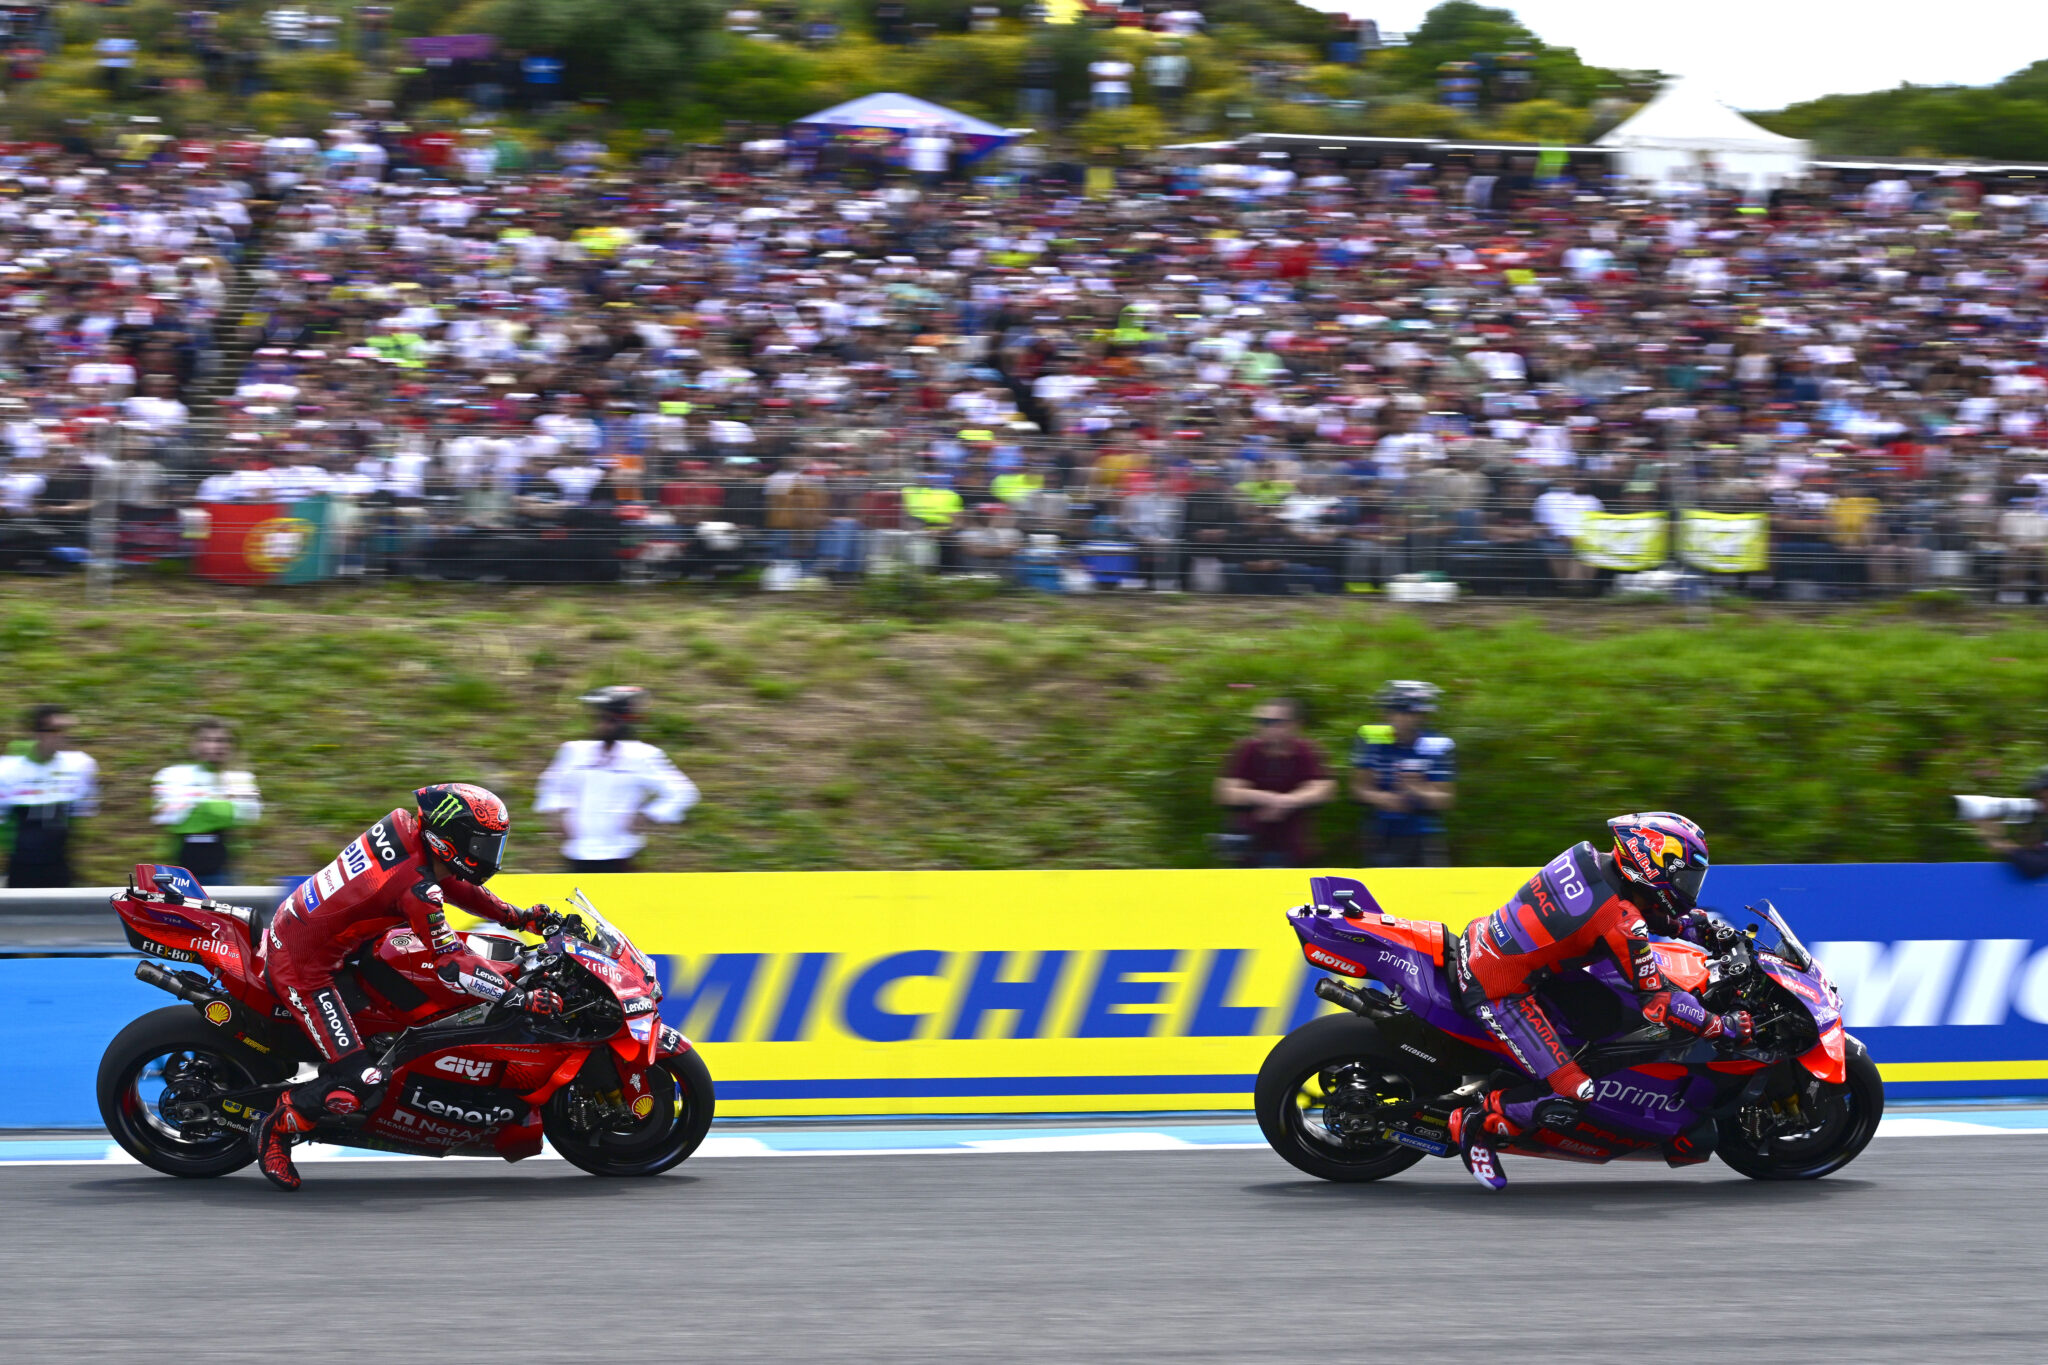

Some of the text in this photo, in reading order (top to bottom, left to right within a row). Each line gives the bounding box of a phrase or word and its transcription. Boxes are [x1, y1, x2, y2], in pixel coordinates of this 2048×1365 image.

[453, 856, 475, 875] Lenovo
[172, 876, 190, 888] TIM
[190, 936, 229, 955] riello
[1310, 950, 1356, 974] MOTUL
[1377, 950, 1419, 976] prima
[1638, 961, 1656, 977] 89
[475, 967, 503, 985] Lenovo
[592, 963, 623, 983] riello
[469, 977, 504, 999] UnipolSa
[624, 1001, 653, 1014] Lenovo
[1676, 1003, 1705, 1022] prima
[318, 991, 350, 1047] Lenovo
[434, 1055, 493, 1078] GIVI
[410, 1085, 515, 1125] Lenovo
[1596, 1080, 1686, 1112] prima
[1401, 1137, 1441, 1151] MICHELIN
[1470, 1145, 1496, 1180] 89
